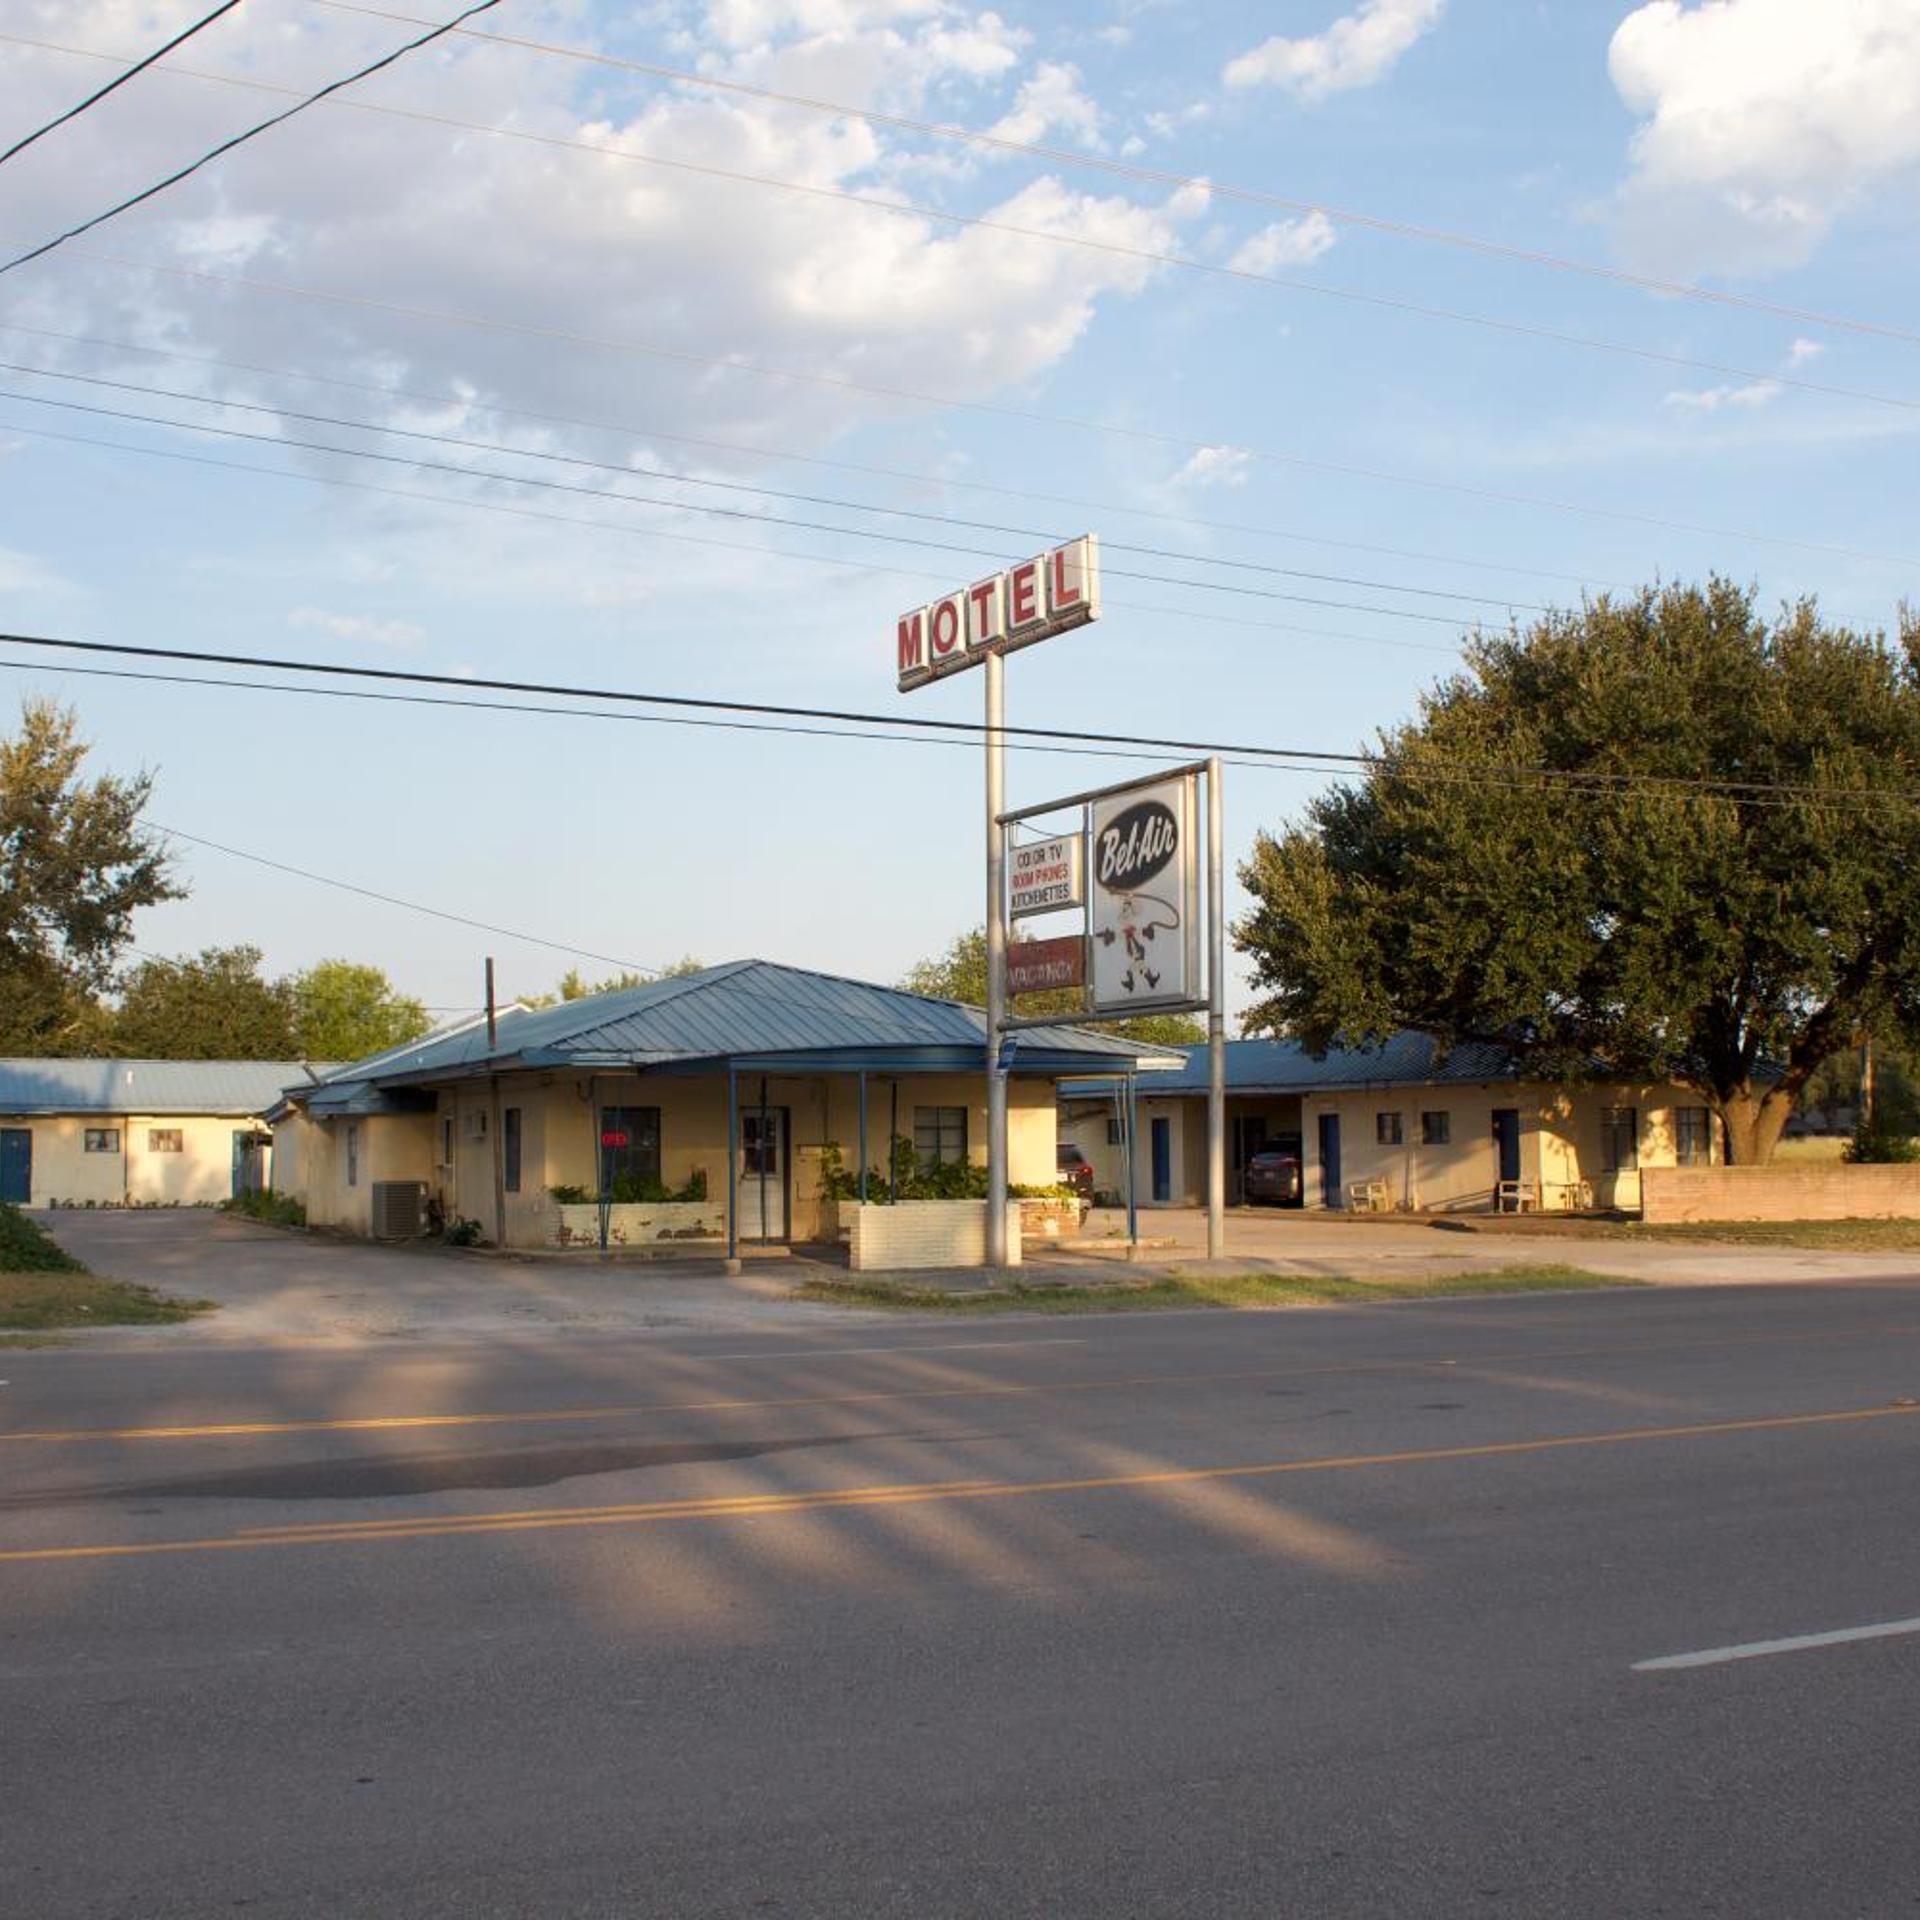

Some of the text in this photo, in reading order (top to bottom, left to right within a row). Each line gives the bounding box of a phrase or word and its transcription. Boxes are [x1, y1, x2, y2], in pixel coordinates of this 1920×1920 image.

[898, 551, 1080, 668] MOTEL
[1017, 845, 1062, 868] COOR TV
